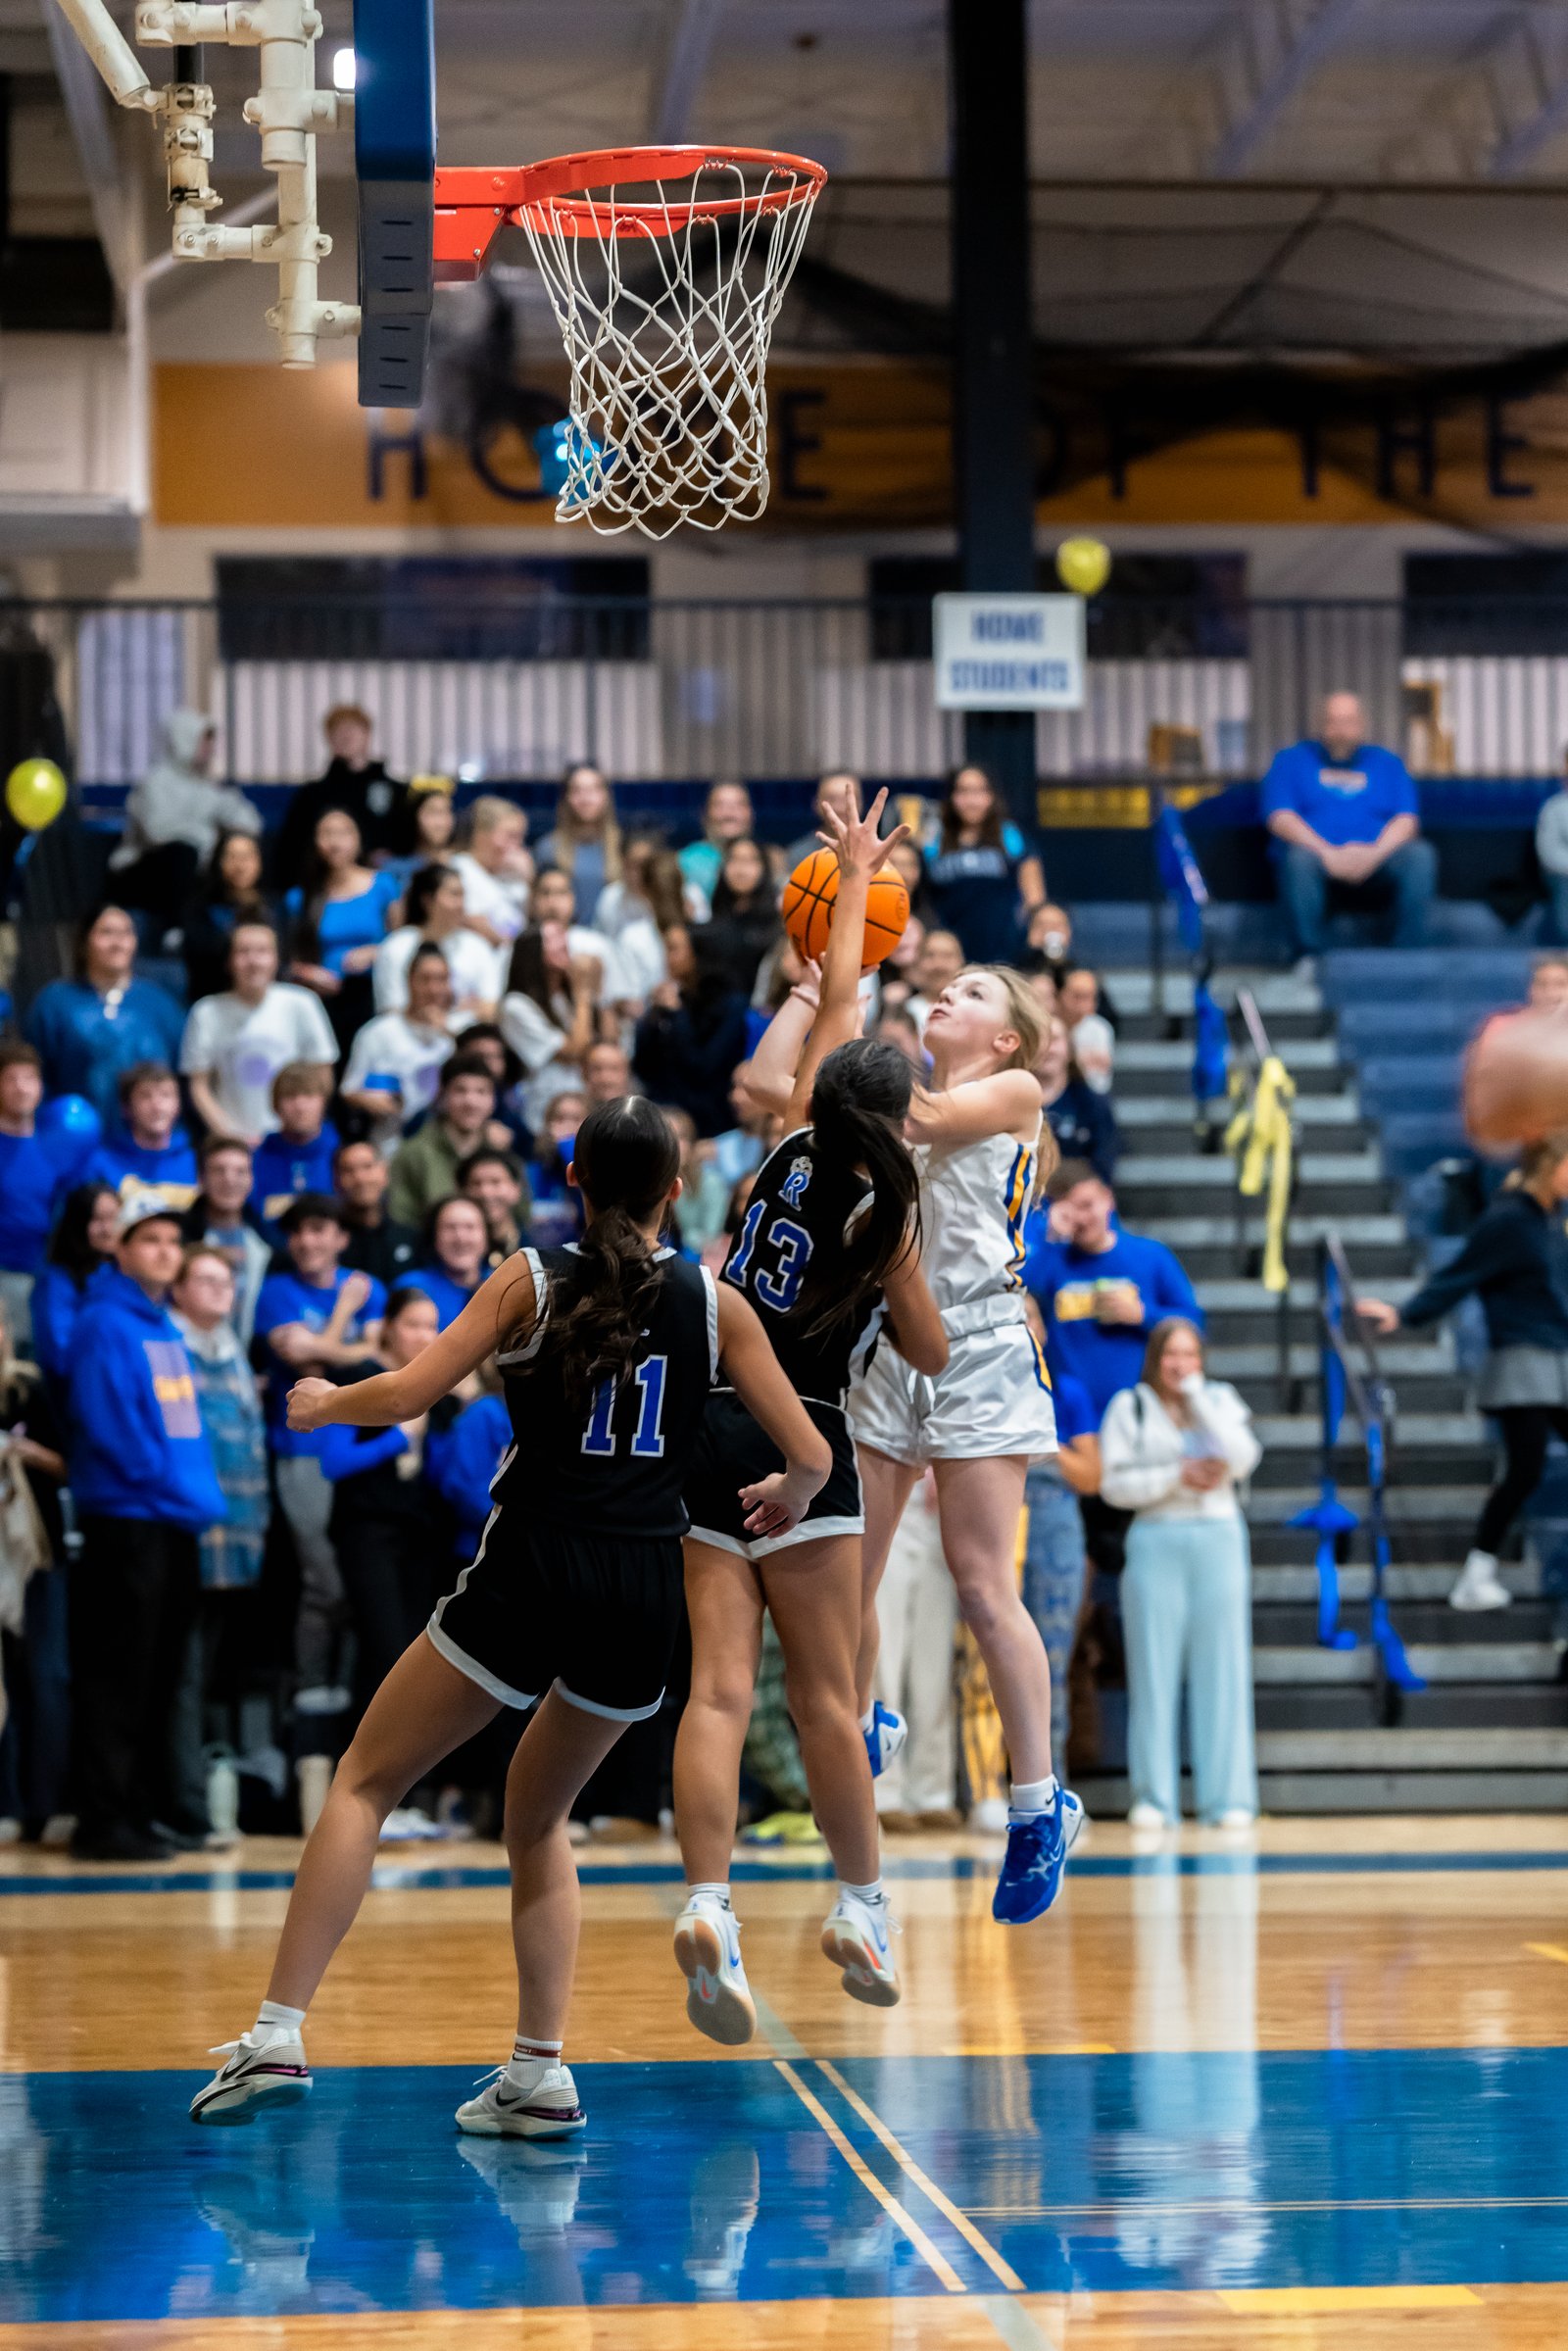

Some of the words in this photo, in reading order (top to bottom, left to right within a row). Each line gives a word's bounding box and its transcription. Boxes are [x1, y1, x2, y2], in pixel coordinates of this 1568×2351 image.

[971, 611, 1044, 643] HOME
[950, 660, 1068, 693] STUDENTS
[725, 1198, 814, 1313] 13
[580, 1354, 667, 1458] 11
